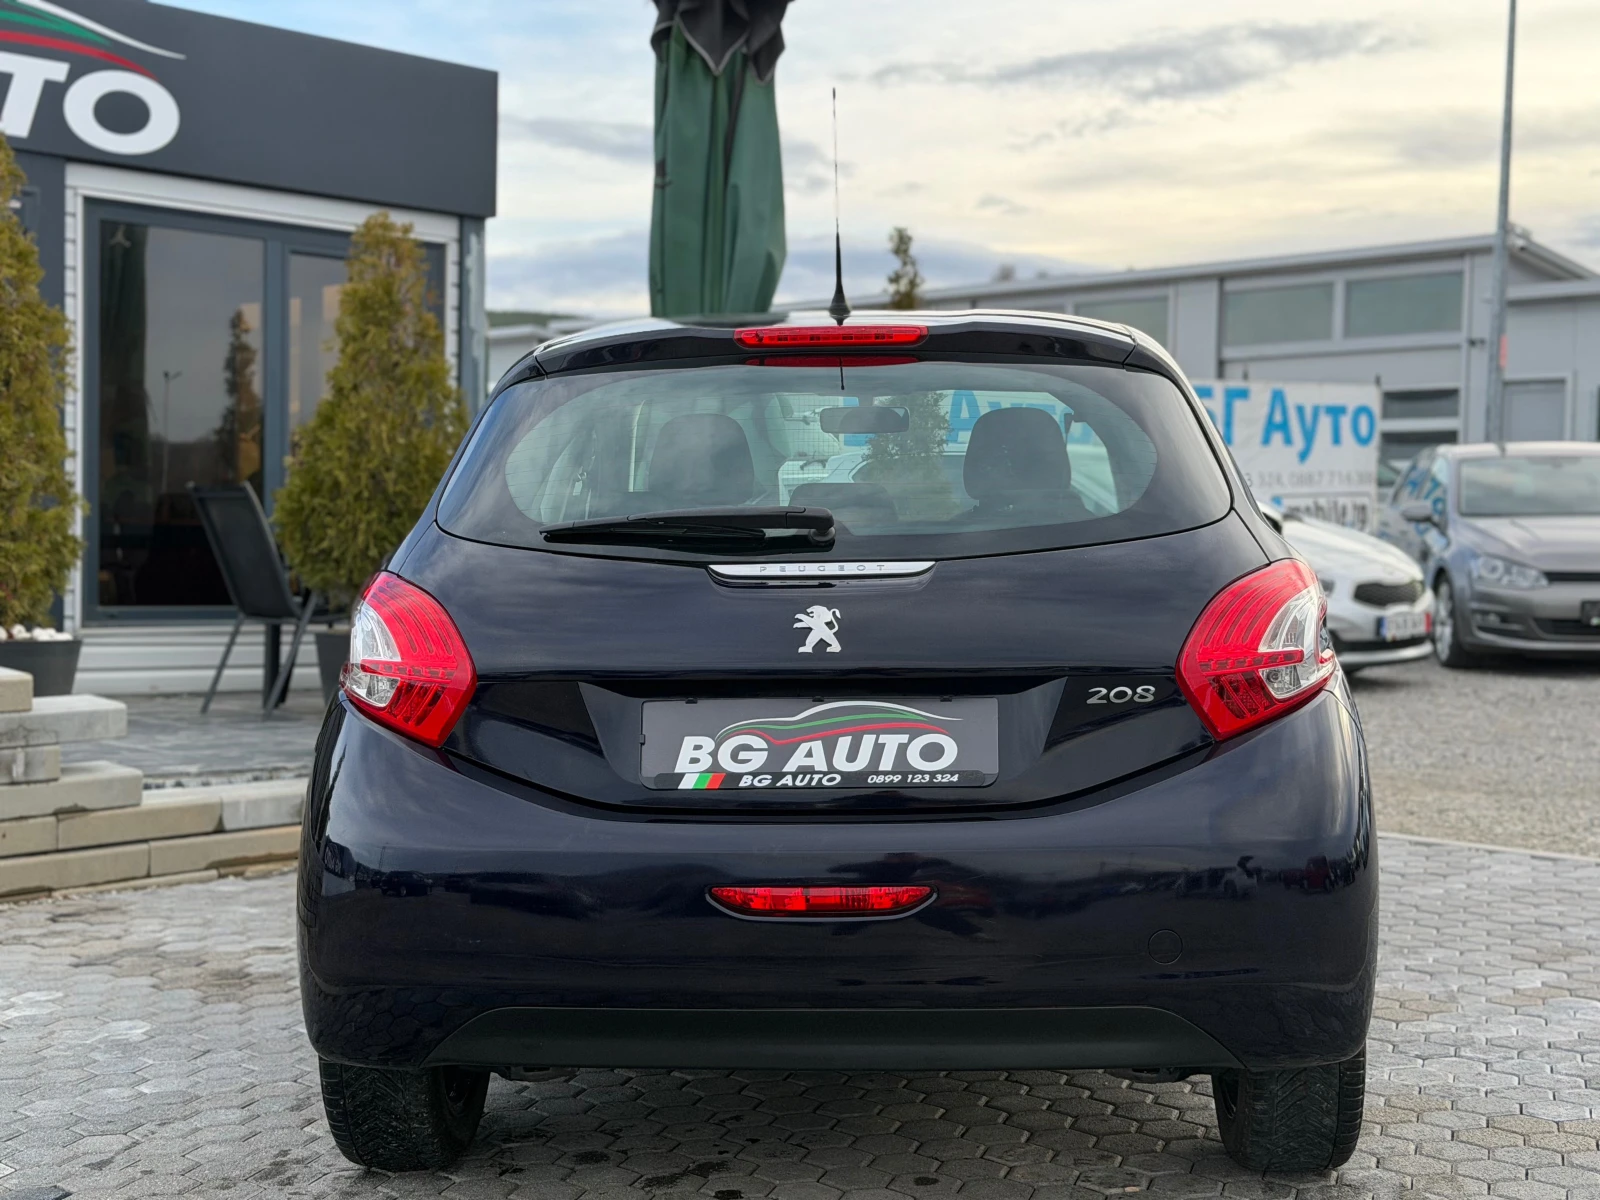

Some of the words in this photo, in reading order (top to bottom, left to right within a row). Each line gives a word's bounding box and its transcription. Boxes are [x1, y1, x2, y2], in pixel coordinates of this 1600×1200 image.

[759, 564, 886, 574] PEUGEOT
[1086, 685, 1156, 705] 208
[674, 735, 769, 774] BG
[781, 734, 959, 773] AUTO
[738, 774, 771, 788] BG
[775, 774, 842, 787] AUTO
[867, 774, 902, 784] 0899
[906, 774, 929, 784] 123
[932, 773, 960, 784] 324
